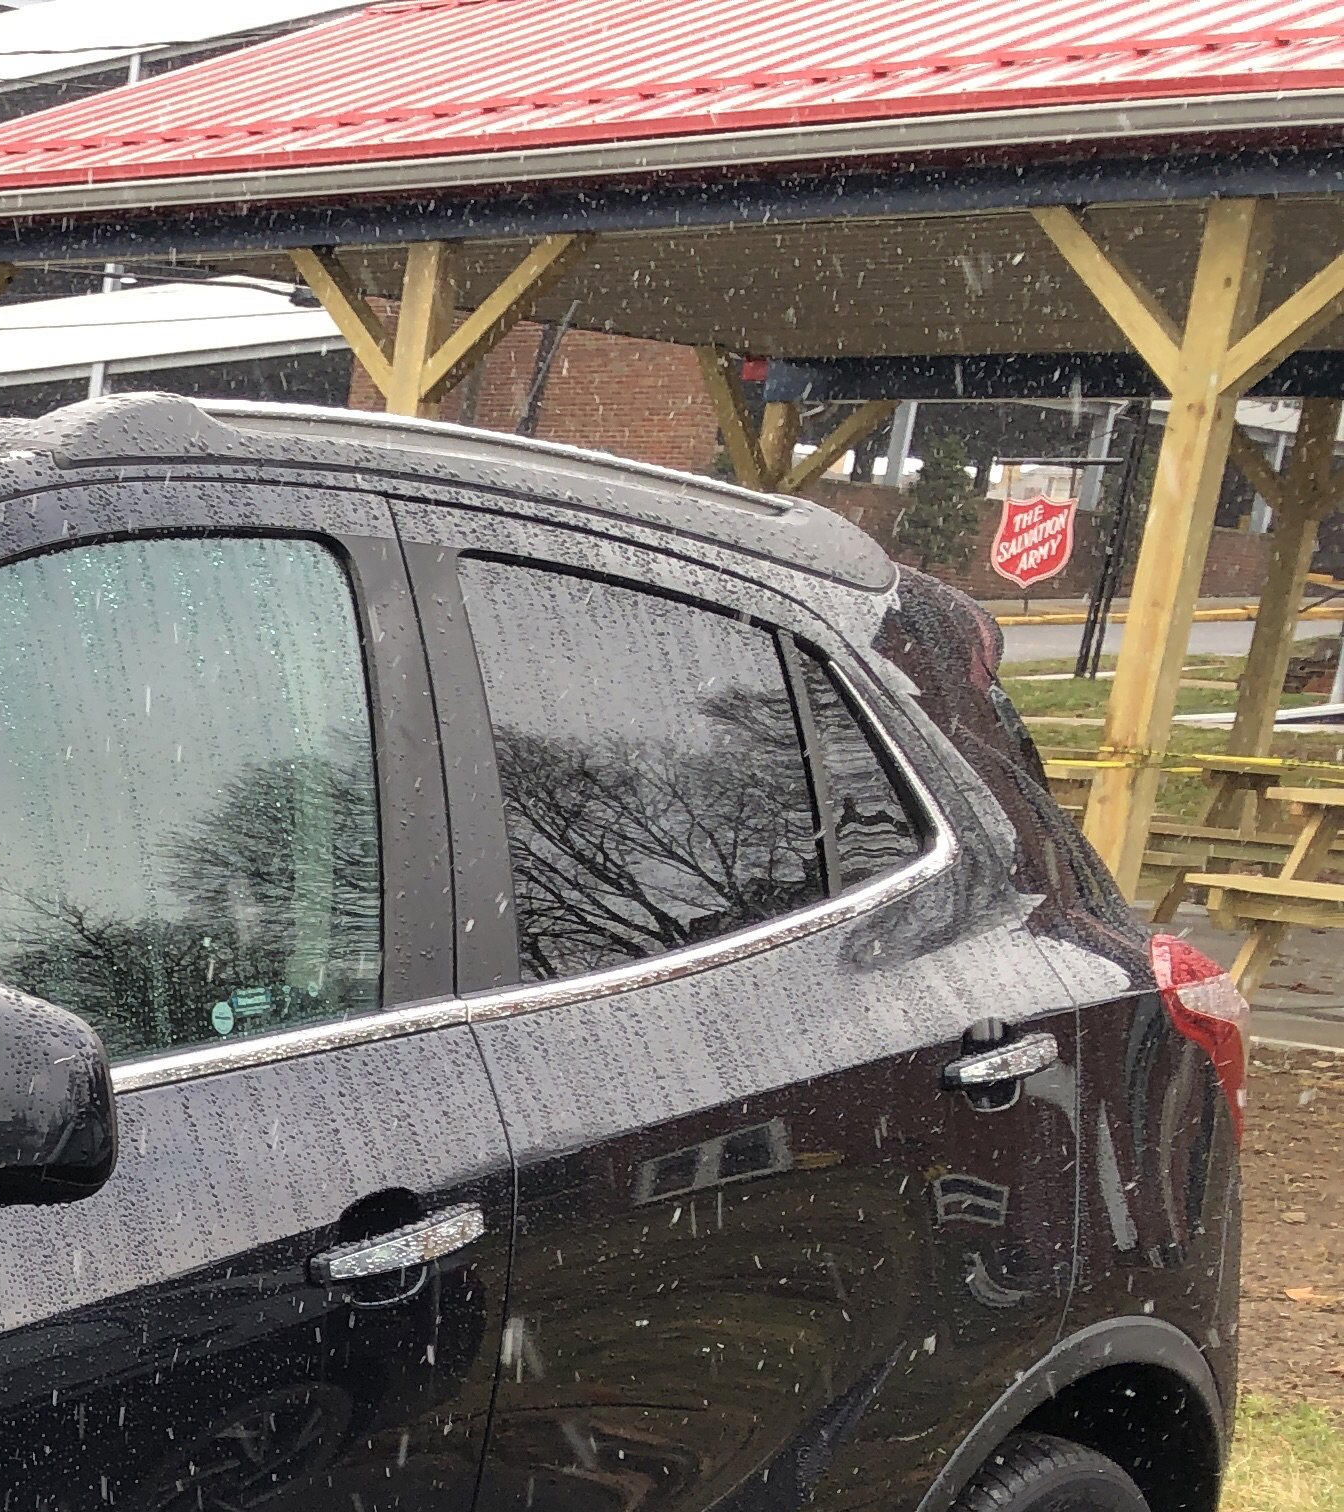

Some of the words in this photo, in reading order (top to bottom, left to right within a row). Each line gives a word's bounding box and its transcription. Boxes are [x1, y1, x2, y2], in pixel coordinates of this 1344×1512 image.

[997, 508, 1069, 563] SALVATION
[1013, 505, 1045, 532] THE
[1015, 534, 1062, 574] ARMY
